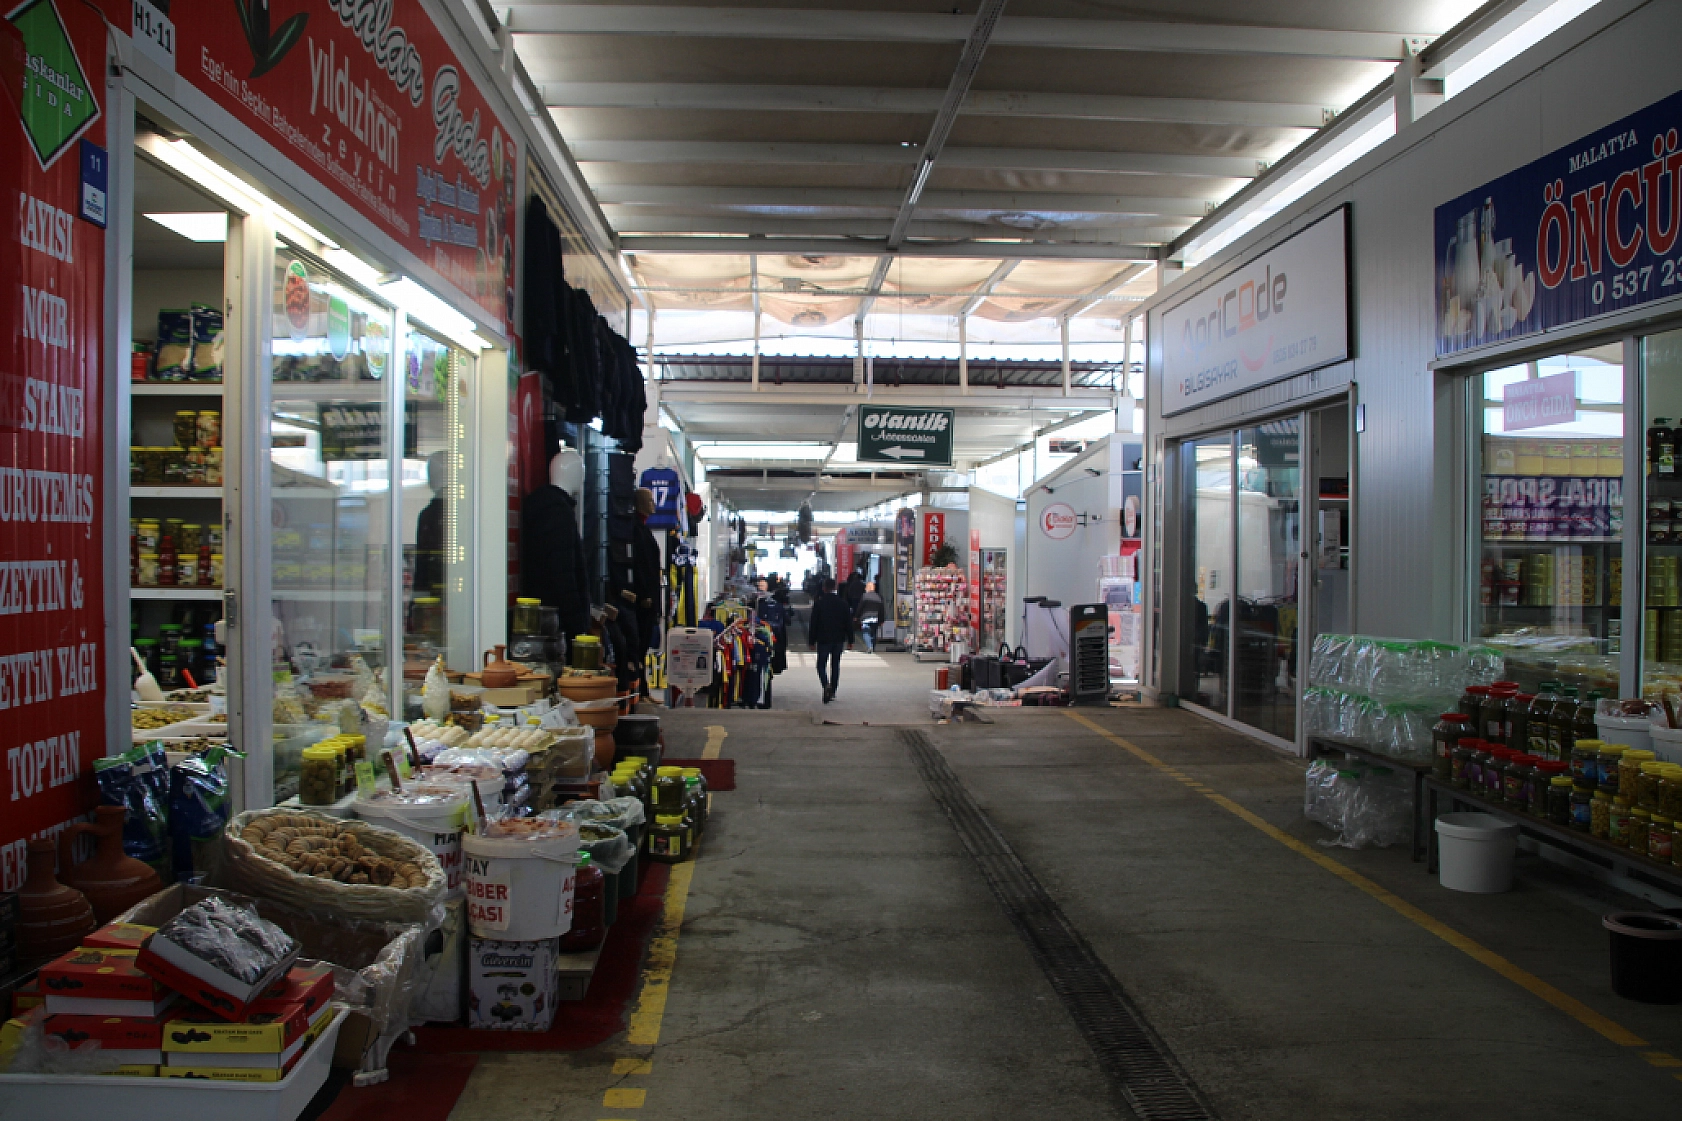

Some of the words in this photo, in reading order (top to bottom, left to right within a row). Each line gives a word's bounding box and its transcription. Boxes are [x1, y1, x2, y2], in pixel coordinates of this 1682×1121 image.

[90, 154, 101, 173] 11
[1568, 129, 1638, 173] MALATYA
[1611, 264, 1654, 300] 537
[21, 377, 84, 439] STANE
[1541, 393, 1572, 418] GIDA
[652, 486, 669, 508] 17
[71, 558, 83, 610] &
[57, 627, 97, 697] YAĞI
[8, 730, 81, 802] TOPTAN
[466, 858, 489, 876] TAY
[468, 904, 503, 923] ÇASI
